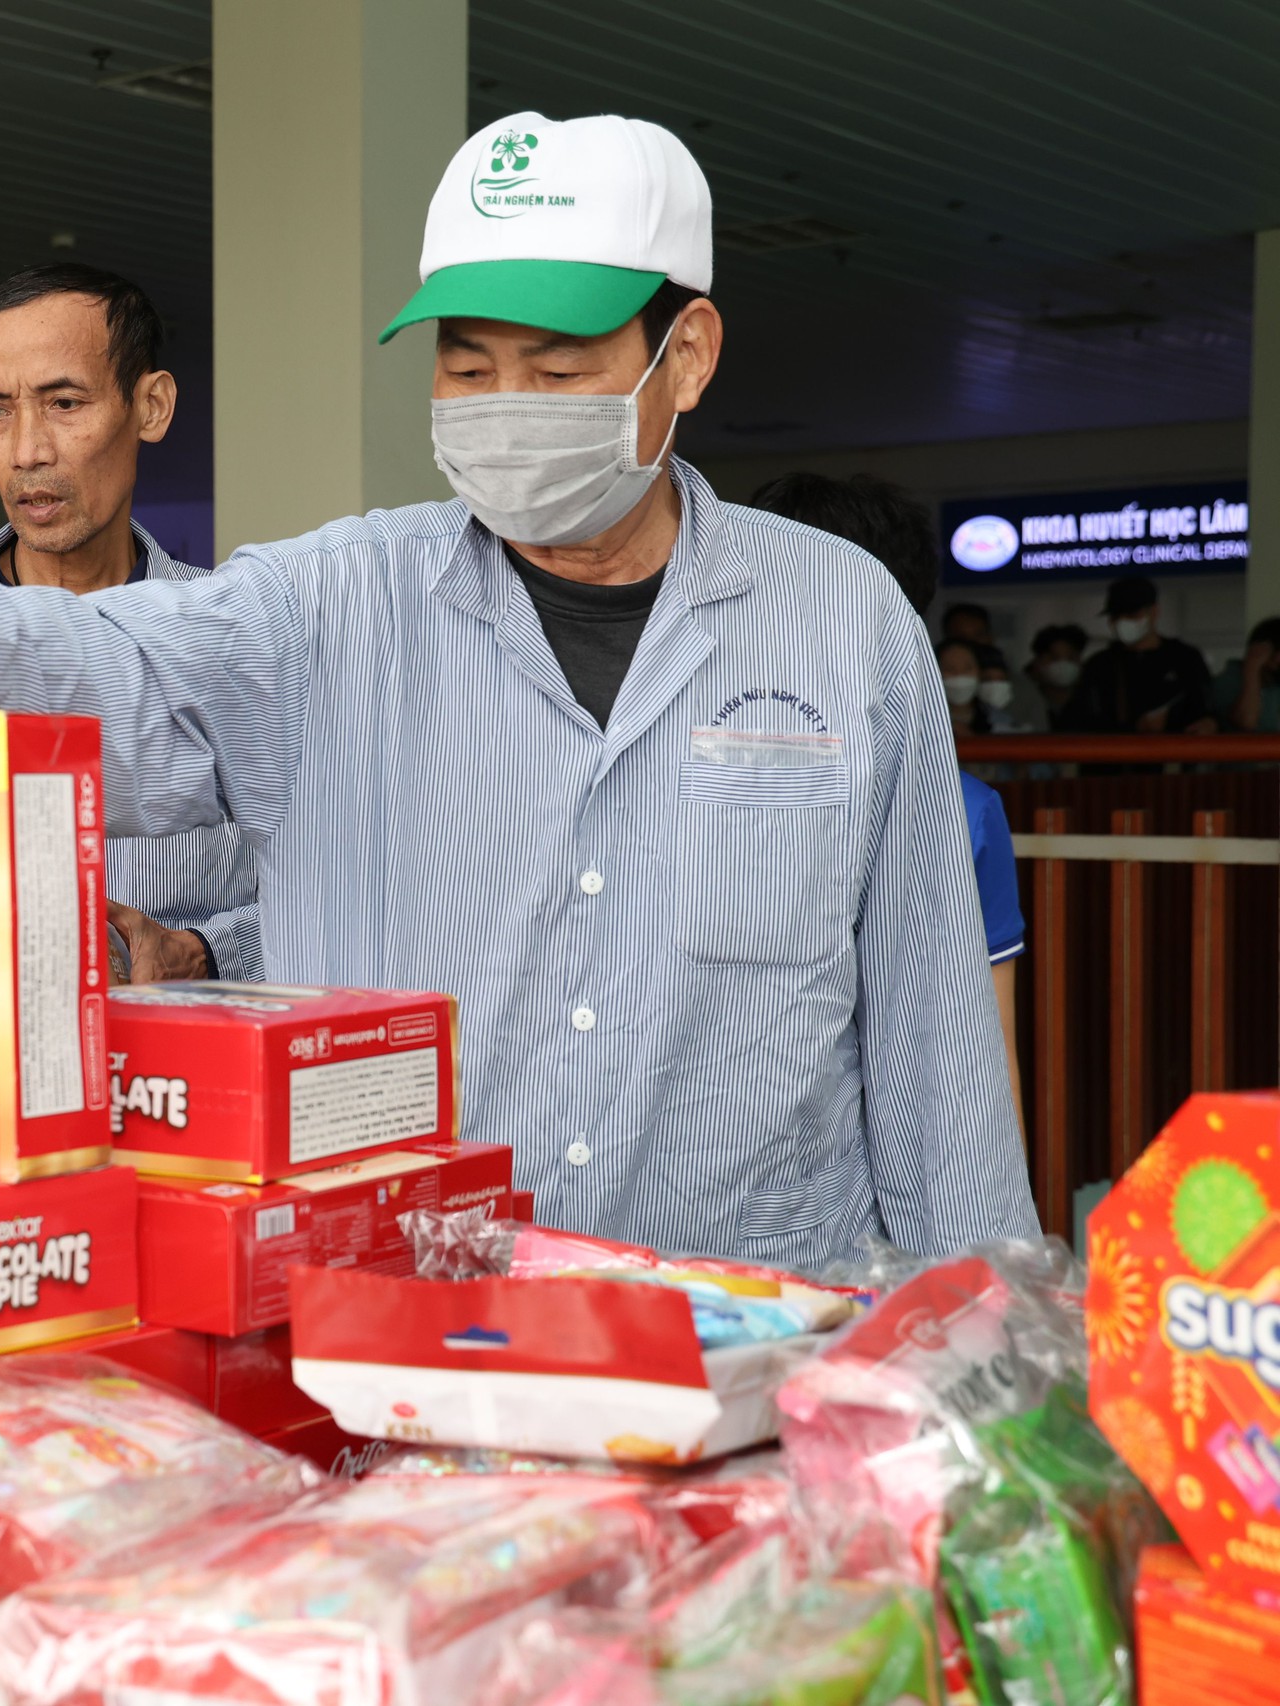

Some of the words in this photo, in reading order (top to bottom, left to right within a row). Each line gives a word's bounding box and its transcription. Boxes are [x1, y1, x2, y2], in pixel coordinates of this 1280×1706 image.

[548, 196, 575, 206] XANH
[1022, 515, 1078, 545] KHOA
[1080, 501, 1148, 541] HUYẾT
[1150, 506, 1197, 541] HỌC
[1022, 549, 1131, 570] HAEMATOLOGY
[1132, 543, 1203, 564] CLINICAL
[1168, 1283, 1280, 1387] sug
